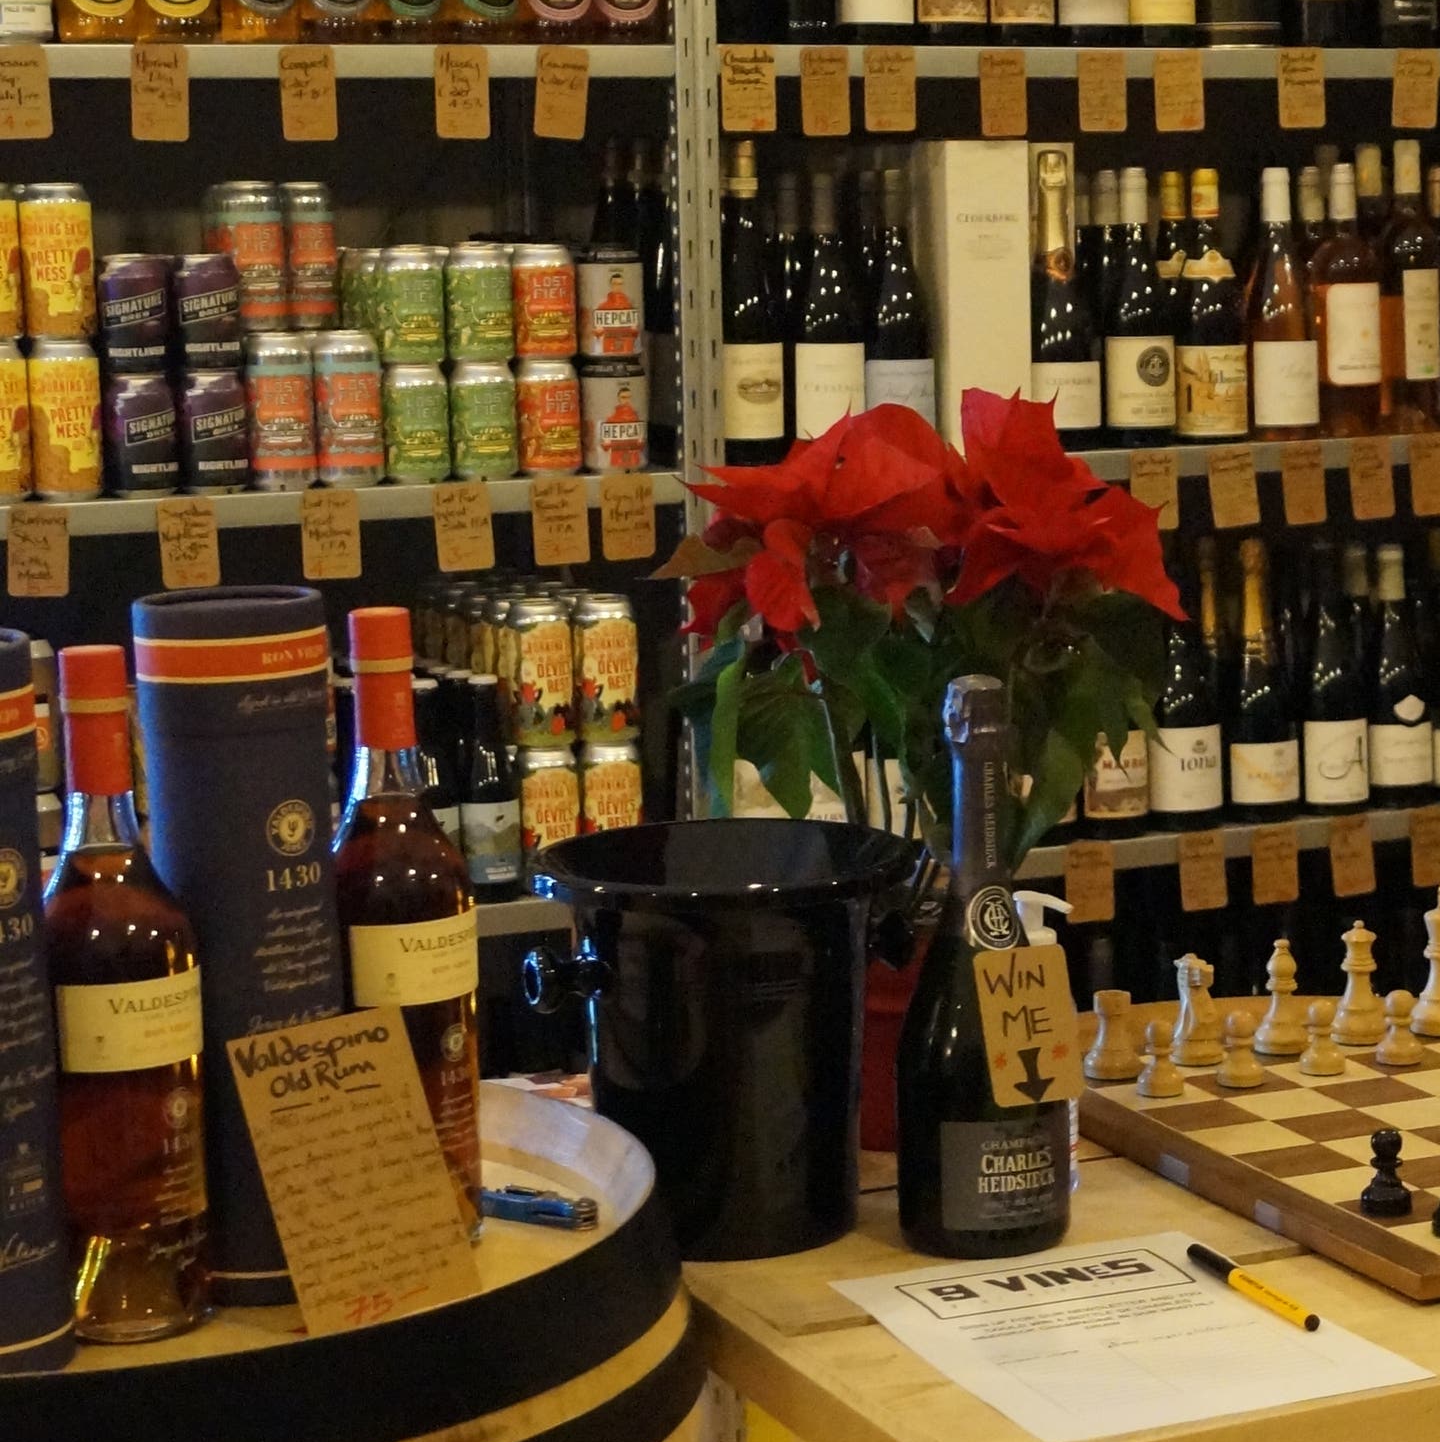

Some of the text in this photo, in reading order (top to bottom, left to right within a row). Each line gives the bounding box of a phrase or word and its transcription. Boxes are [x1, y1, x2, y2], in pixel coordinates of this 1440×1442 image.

[280, 54, 329, 77] Conquest
[956, 212, 1020, 224] CEDERBERG
[31, 250, 73, 265] PRETTY
[36, 267, 67, 282] MESS
[533, 274, 568, 288] LOST
[106, 291, 163, 317] SIGNATURE
[594, 311, 638, 326] HEPCAT
[56, 424, 87, 439] MESS
[261, 649, 294, 665] RON
[607, 674, 632, 690] REST
[546, 823, 573, 840] REST
[265, 860, 322, 893] 1430
[983, 952, 1046, 998] WIN
[1002, 1004, 1054, 1042] ME
[234, 1025, 390, 1079] Valdespino
[269, 1059, 377, 1099] Old Rum
[981, 1149, 1053, 1175] CHARLES
[984, 1257, 1155, 1293] VINES
[343, 1290, 394, 1325] 75
